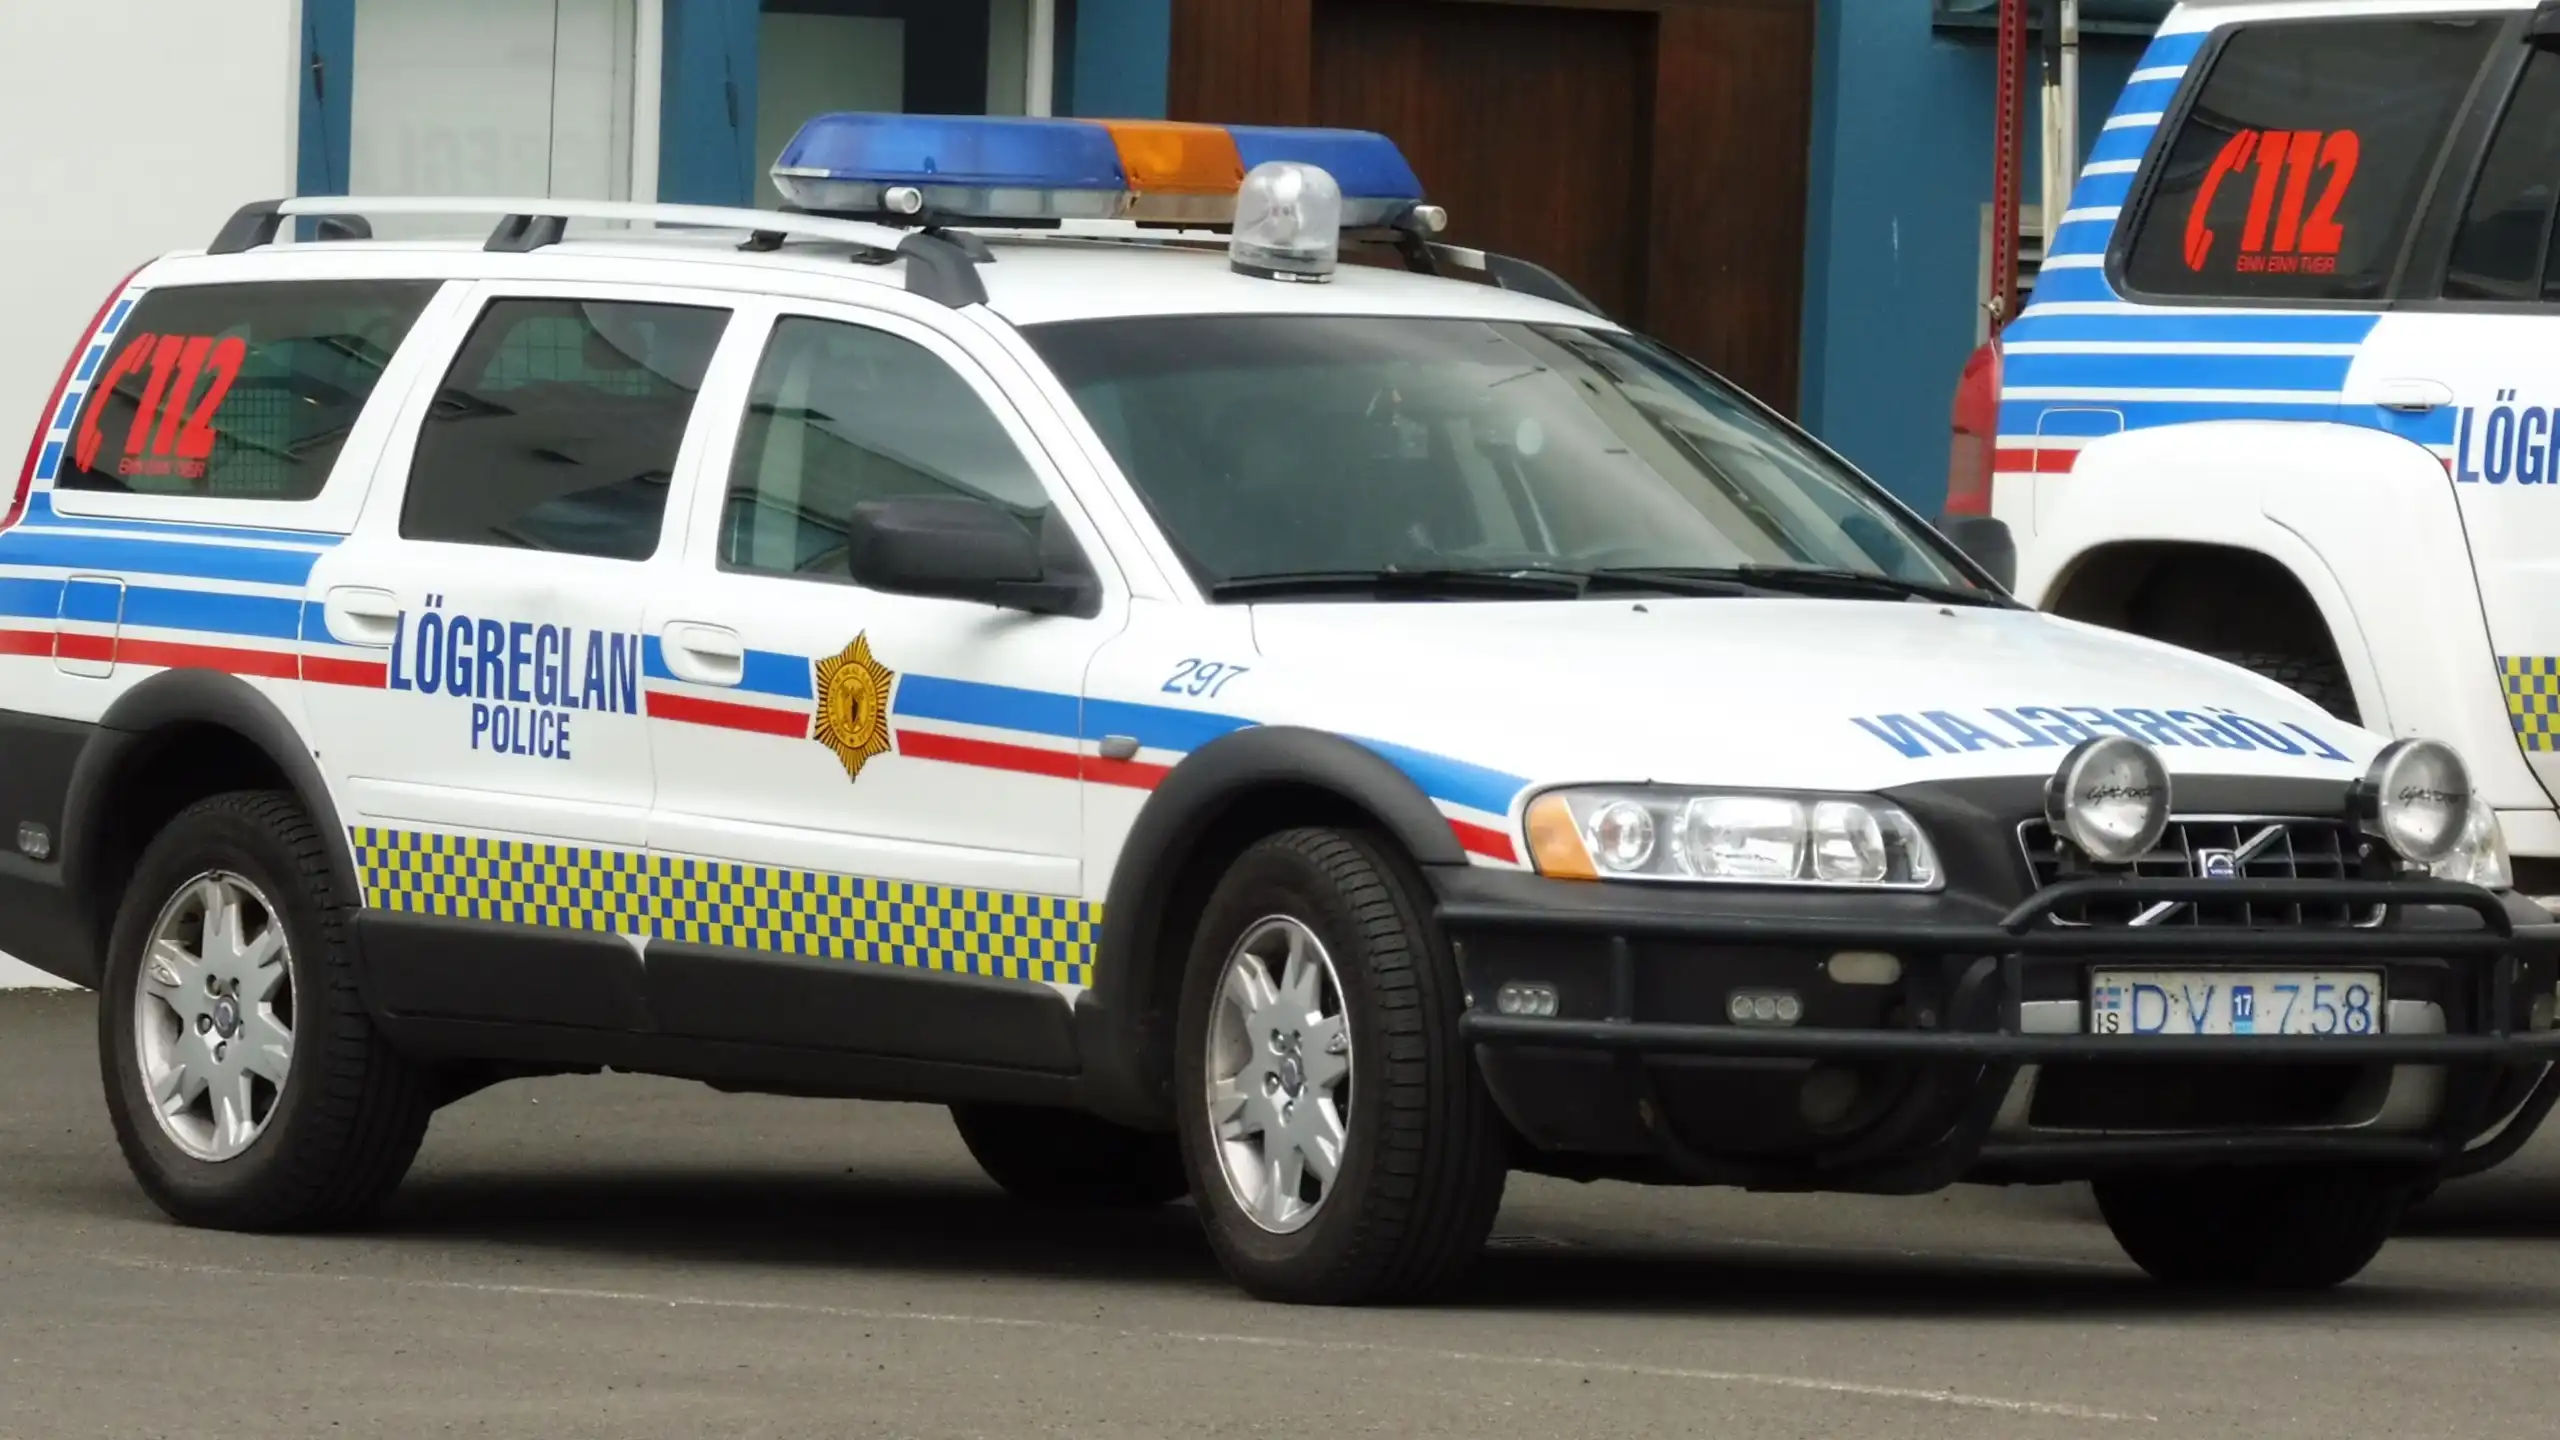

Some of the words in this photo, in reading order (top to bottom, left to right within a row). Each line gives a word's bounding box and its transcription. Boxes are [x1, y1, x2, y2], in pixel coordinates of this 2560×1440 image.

[2239, 129, 2360, 253] 112
[125, 334, 247, 458] 112
[391, 593, 637, 715] LÖGREGLAN
[1161, 658, 1250, 698] 297
[471, 702, 570, 760] POLICE
[2132, 984, 2216, 1034] DV
[2273, 984, 2371, 1034] 758
[2234, 994, 2253, 1016] 17
